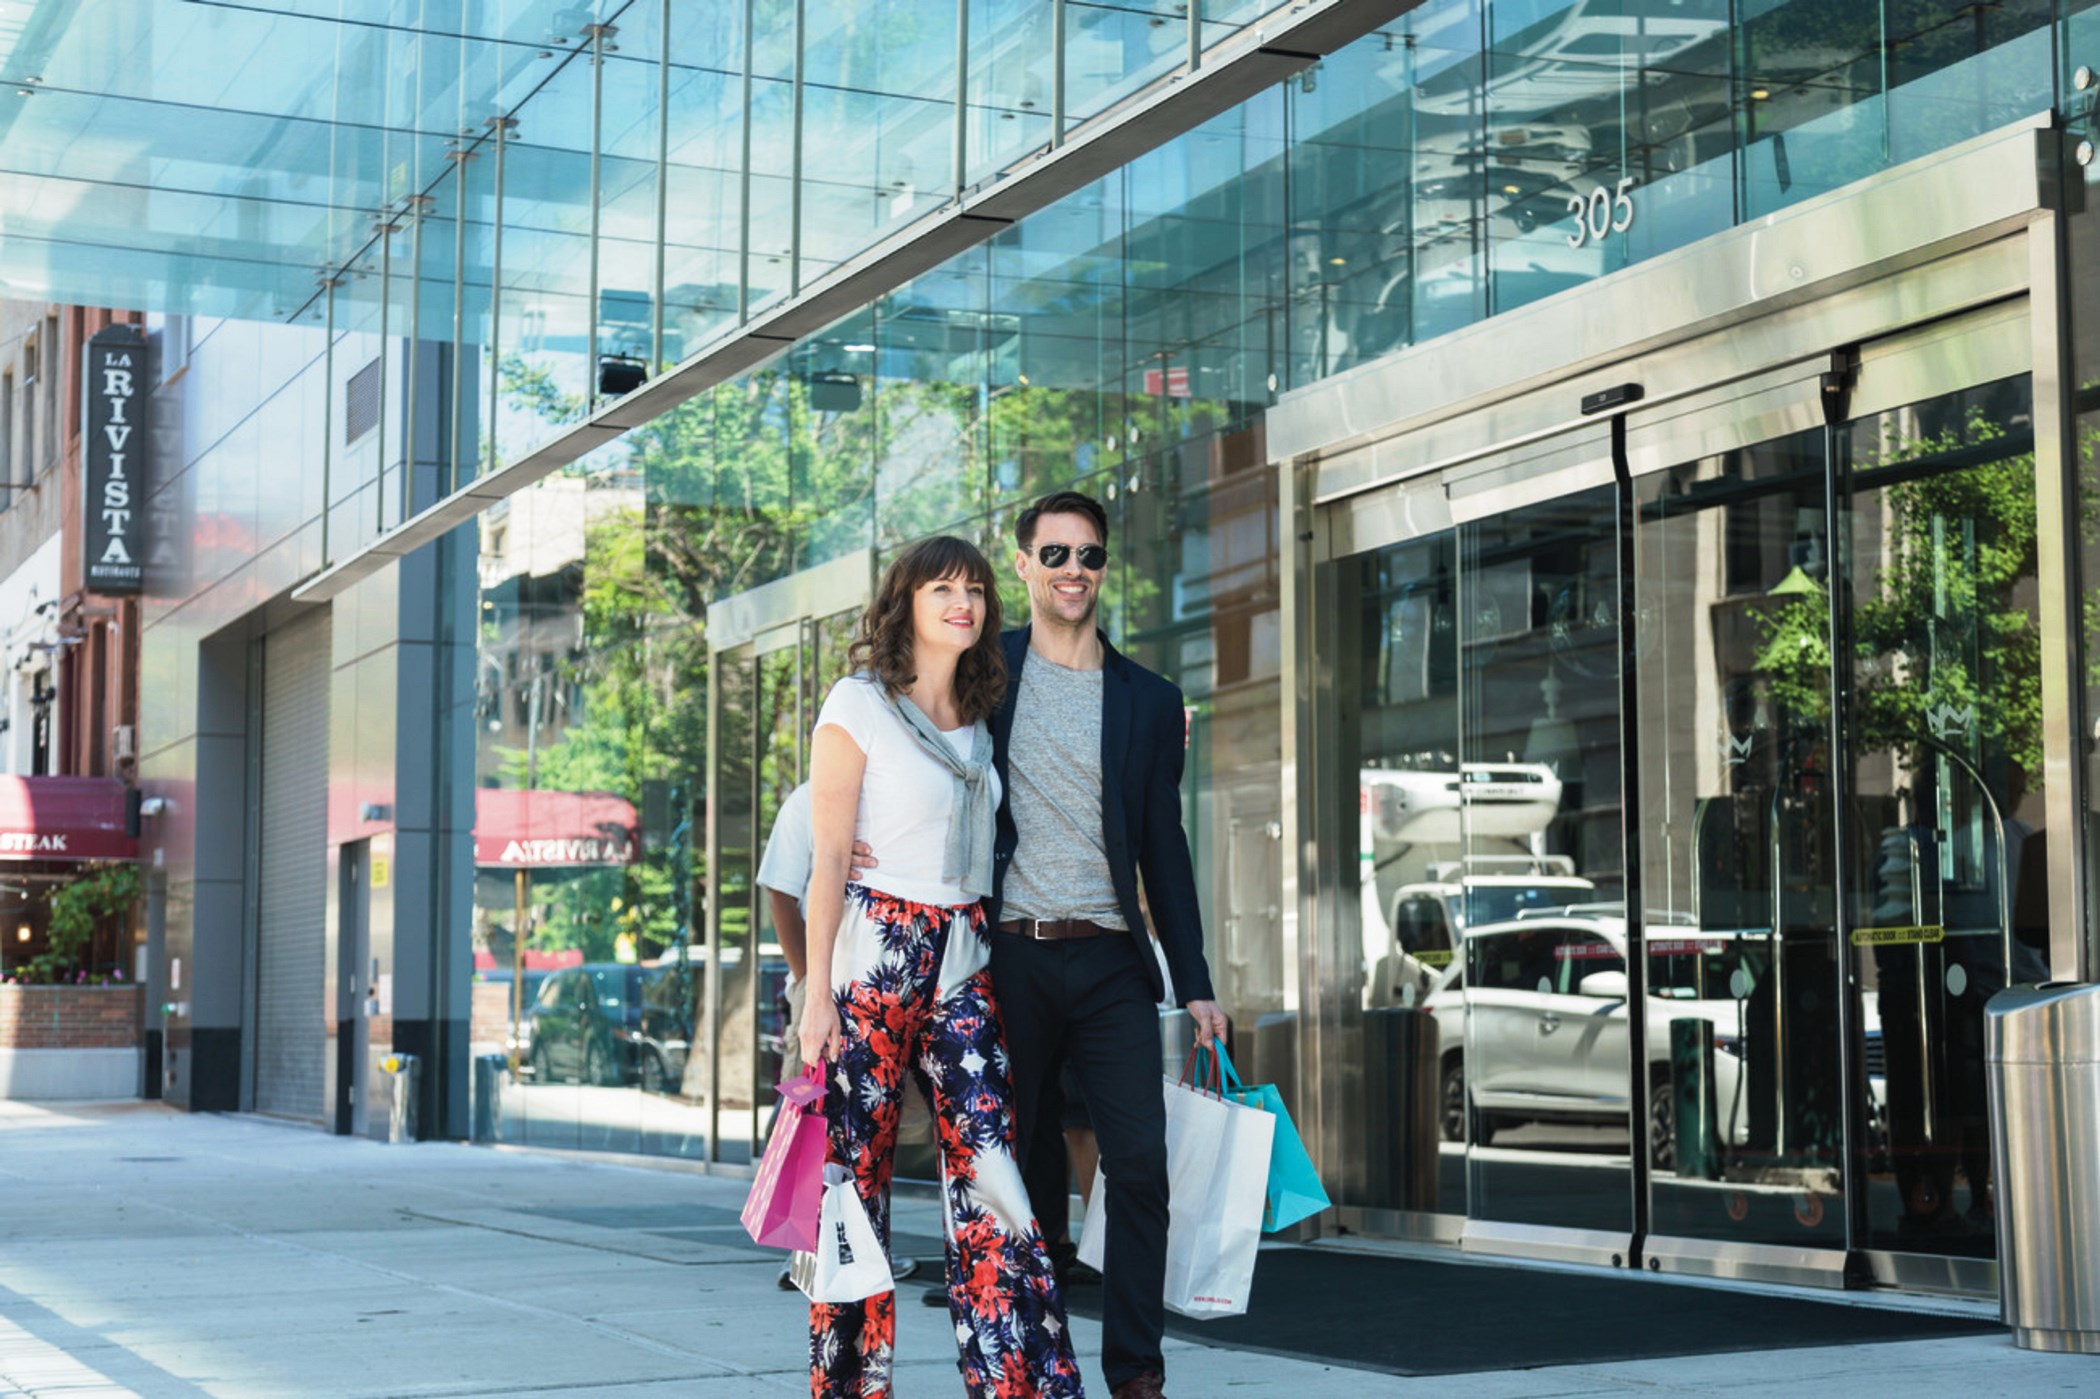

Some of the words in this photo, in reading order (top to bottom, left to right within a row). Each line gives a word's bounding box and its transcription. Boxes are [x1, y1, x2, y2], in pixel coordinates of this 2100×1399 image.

[1566, 176, 1633, 248] 305
[105, 352, 132, 367] LA
[101, 369, 134, 564] RIVISTA
